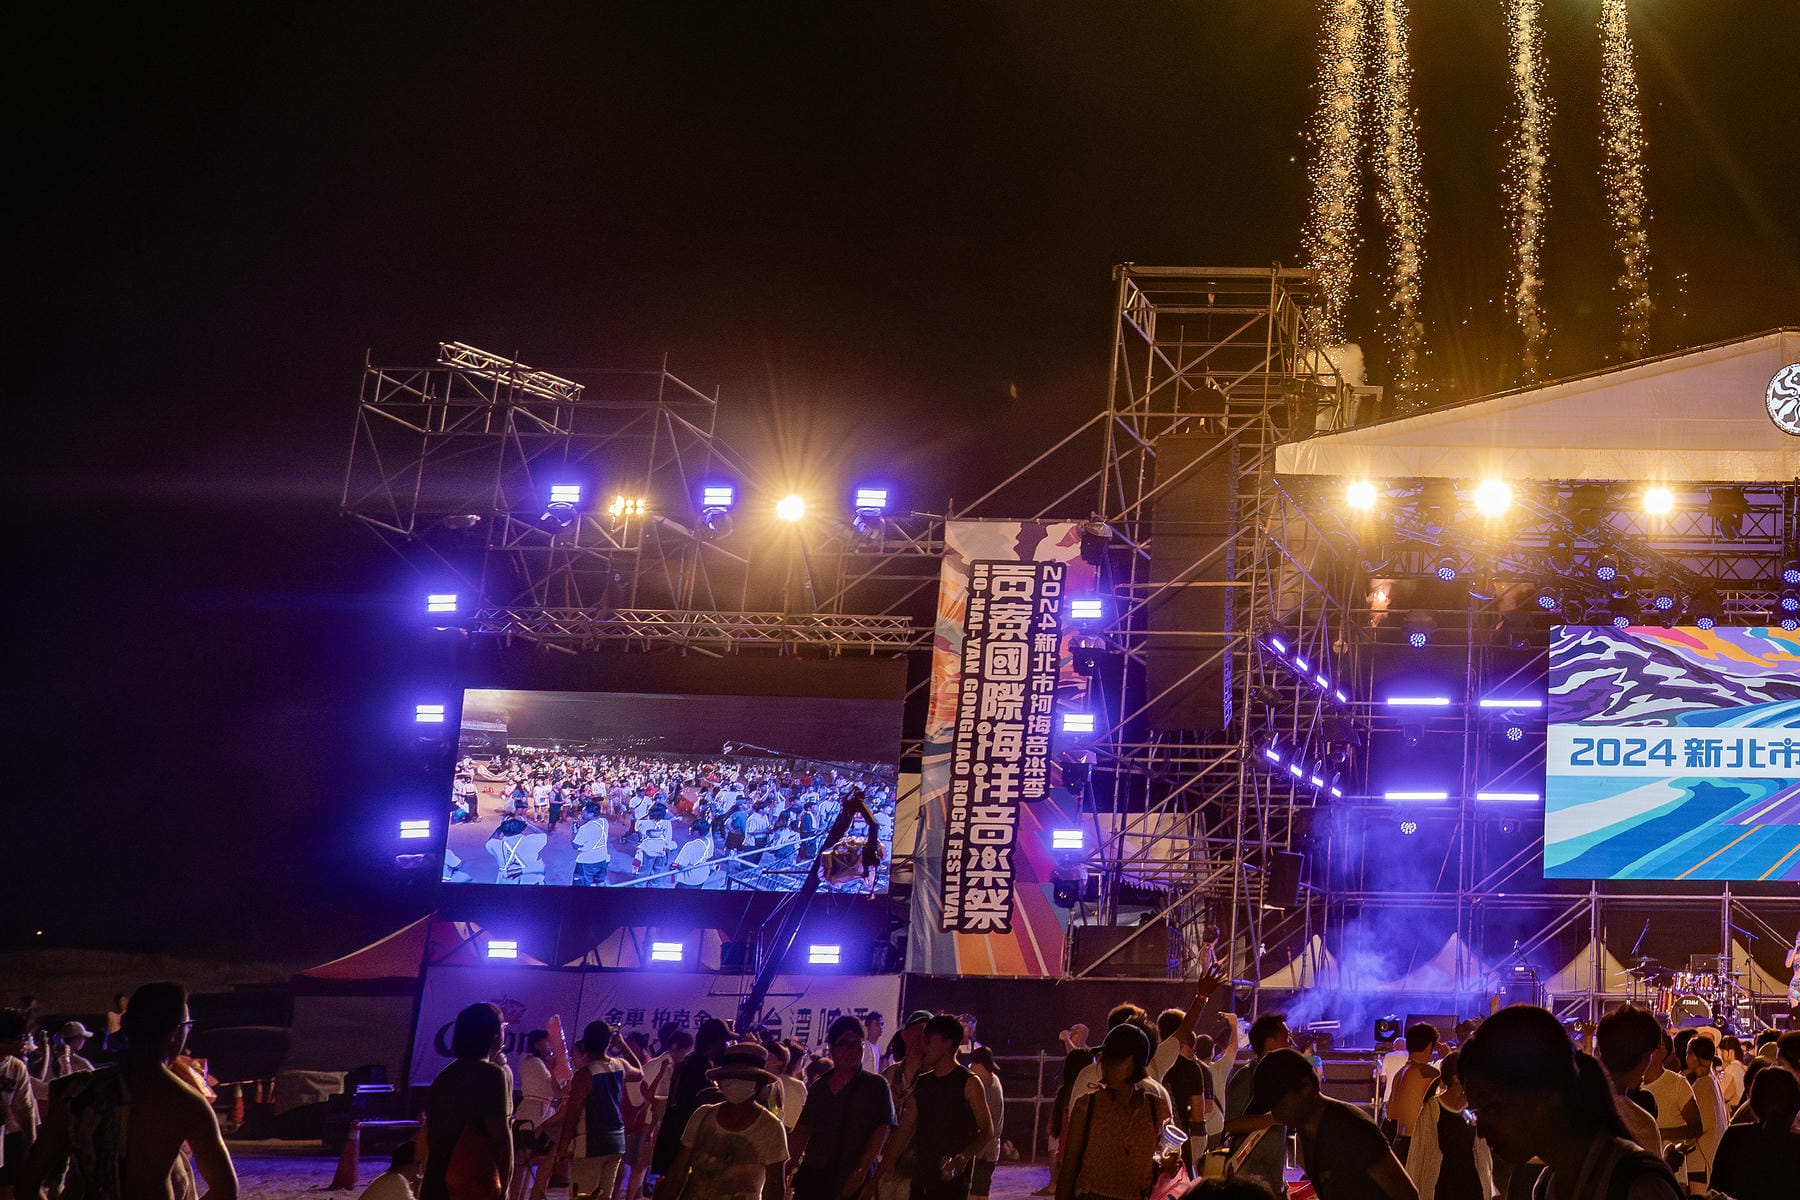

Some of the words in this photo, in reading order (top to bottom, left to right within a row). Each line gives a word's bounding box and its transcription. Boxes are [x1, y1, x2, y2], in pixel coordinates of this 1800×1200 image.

[965, 564, 989, 674] HO-HAI-YAN
[955, 678, 979, 775] GONGLIAO
[950, 779, 969, 835] ROCK
[943, 839, 964, 928] FESTIVAL
